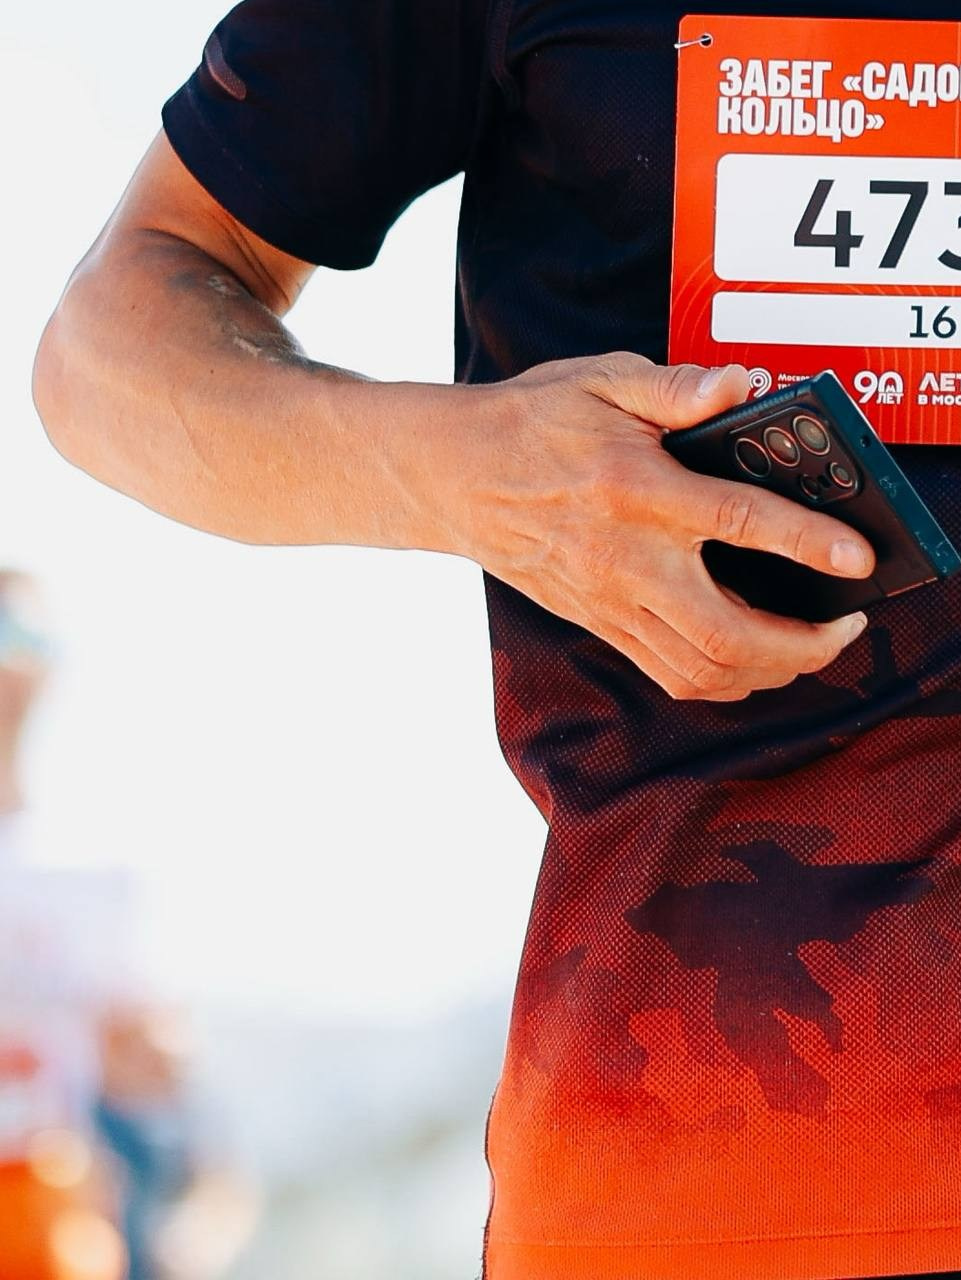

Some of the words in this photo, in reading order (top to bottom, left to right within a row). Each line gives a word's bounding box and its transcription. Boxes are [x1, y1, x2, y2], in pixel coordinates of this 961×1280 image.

[718, 58, 832, 98] ЗАБЕГ
[717, 96, 885, 143] КОЛЬЦО»
[909, 304, 957, 339] 16
[876, 393, 904, 405] ЛЕТ
[918, 394, 928, 405] В
